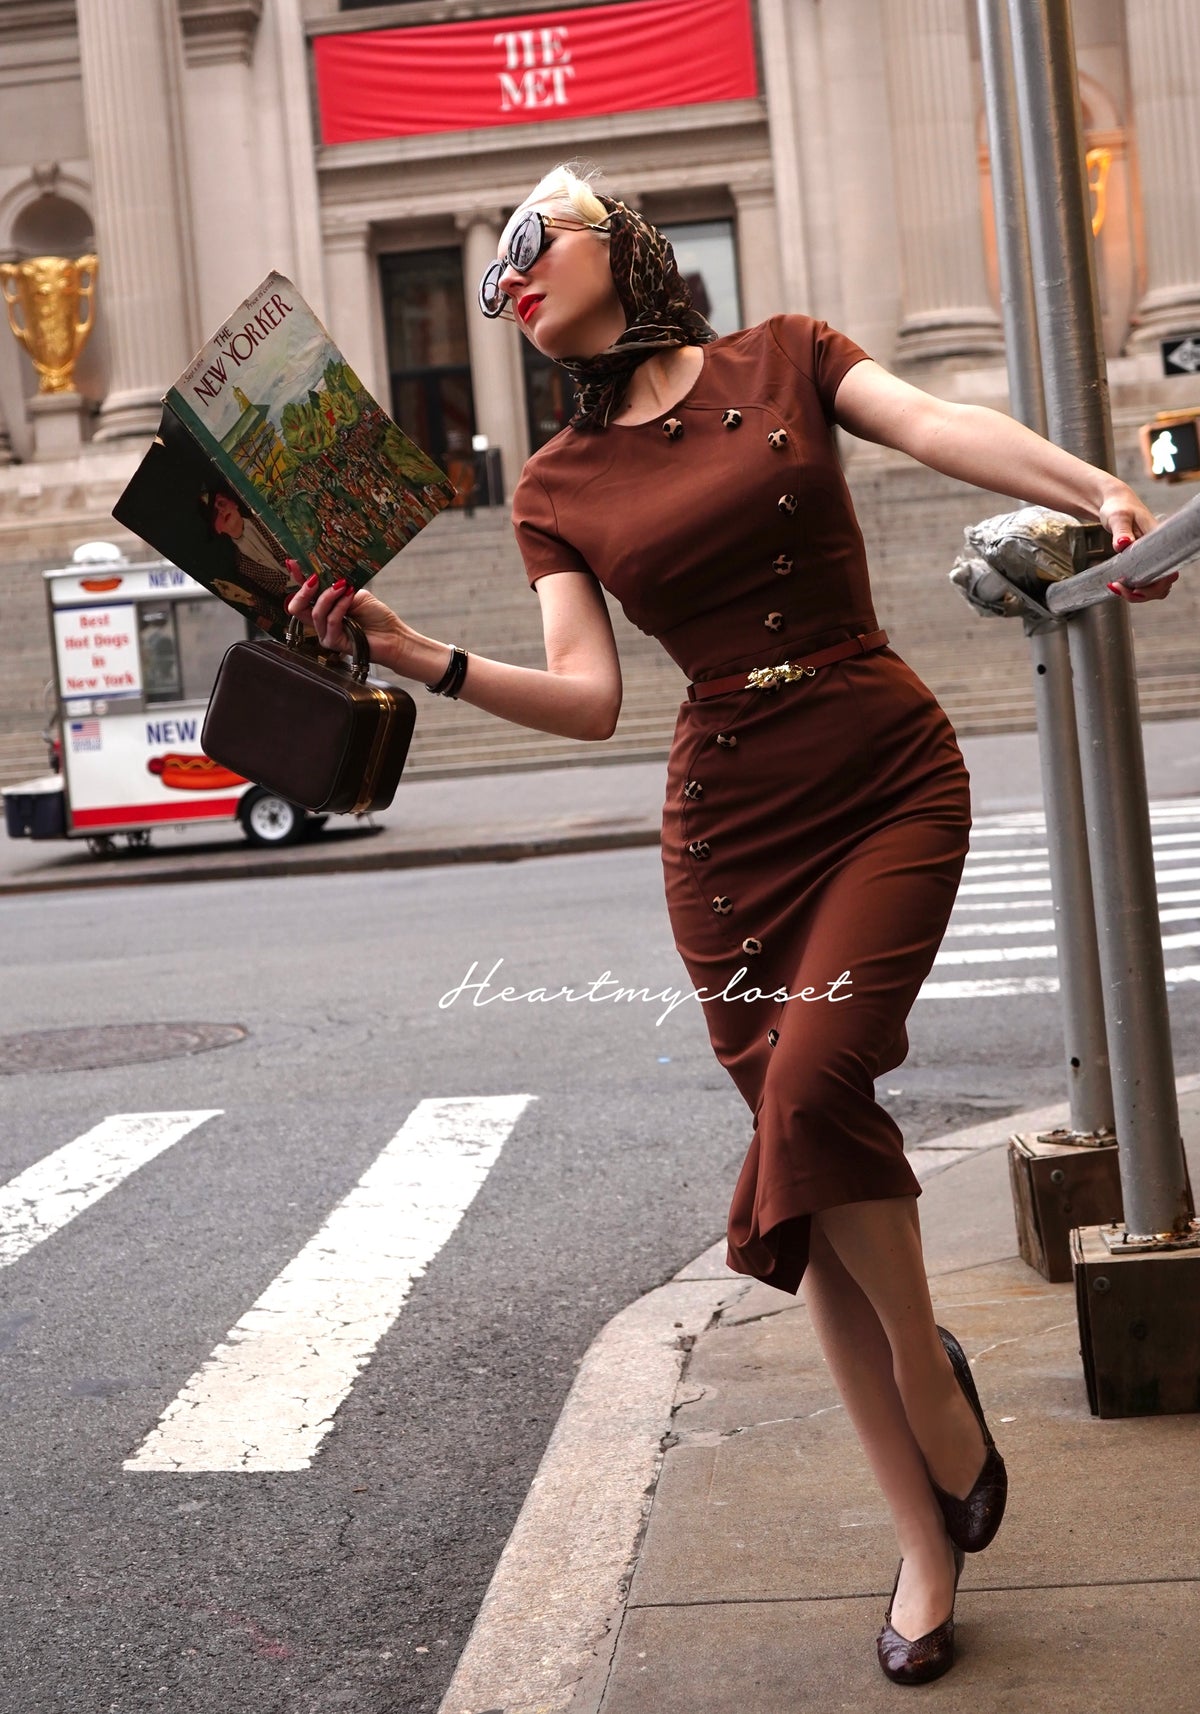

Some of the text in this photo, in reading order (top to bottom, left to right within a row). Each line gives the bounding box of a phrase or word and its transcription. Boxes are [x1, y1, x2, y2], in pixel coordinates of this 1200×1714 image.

[493, 25, 572, 70] THE
[497, 65, 576, 112] MET
[213, 326, 234, 348] THE
[193, 294, 294, 407] NEW YORKER
[149, 571, 185, 588] NEW
[80, 614, 109, 628] Best
[65, 633, 129, 650] Hot Dogs
[91, 655, 105, 669] in
[66, 671, 134, 691] New York
[146, 719, 197, 745] NEW
